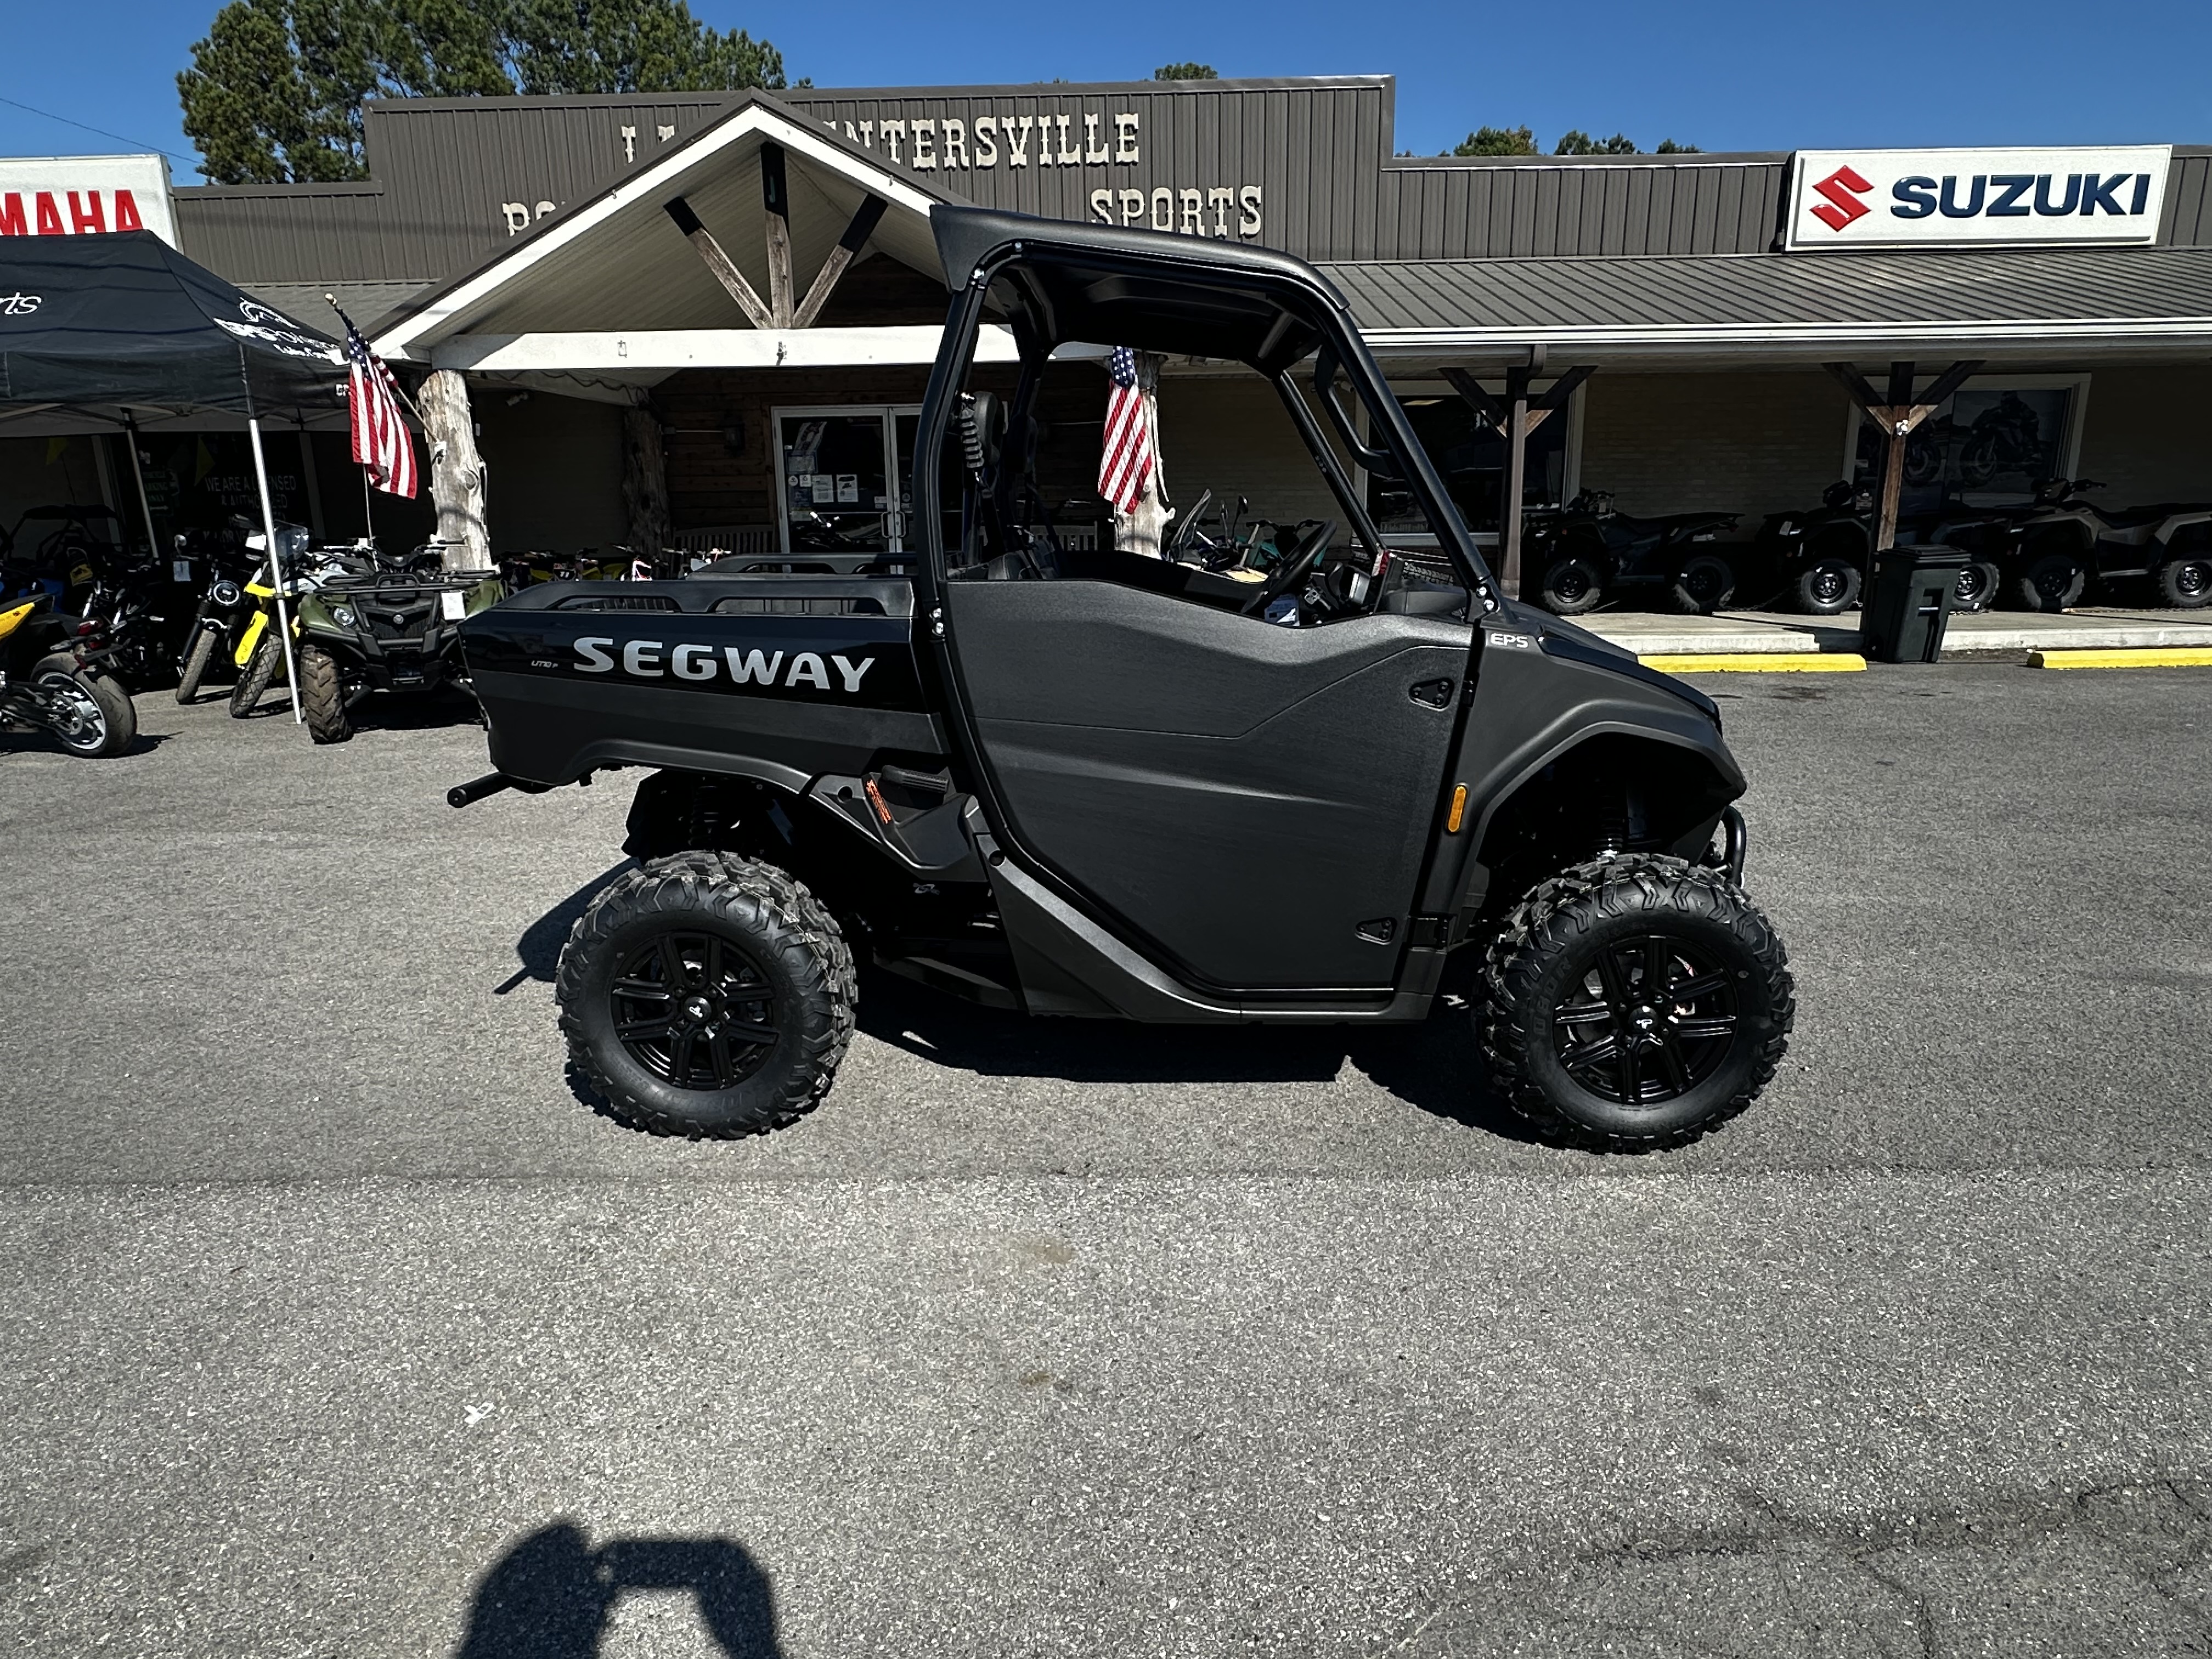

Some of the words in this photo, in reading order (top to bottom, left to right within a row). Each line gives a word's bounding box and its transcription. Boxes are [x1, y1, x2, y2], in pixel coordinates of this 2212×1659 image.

[1091, 185, 1262, 238] SPORTS
[1891, 173, 2151, 218] SUZUKI
[223, 476, 241, 492] ARE
[1491, 633, 1528, 648] EPS
[573, 636, 876, 692] SEGWAY
